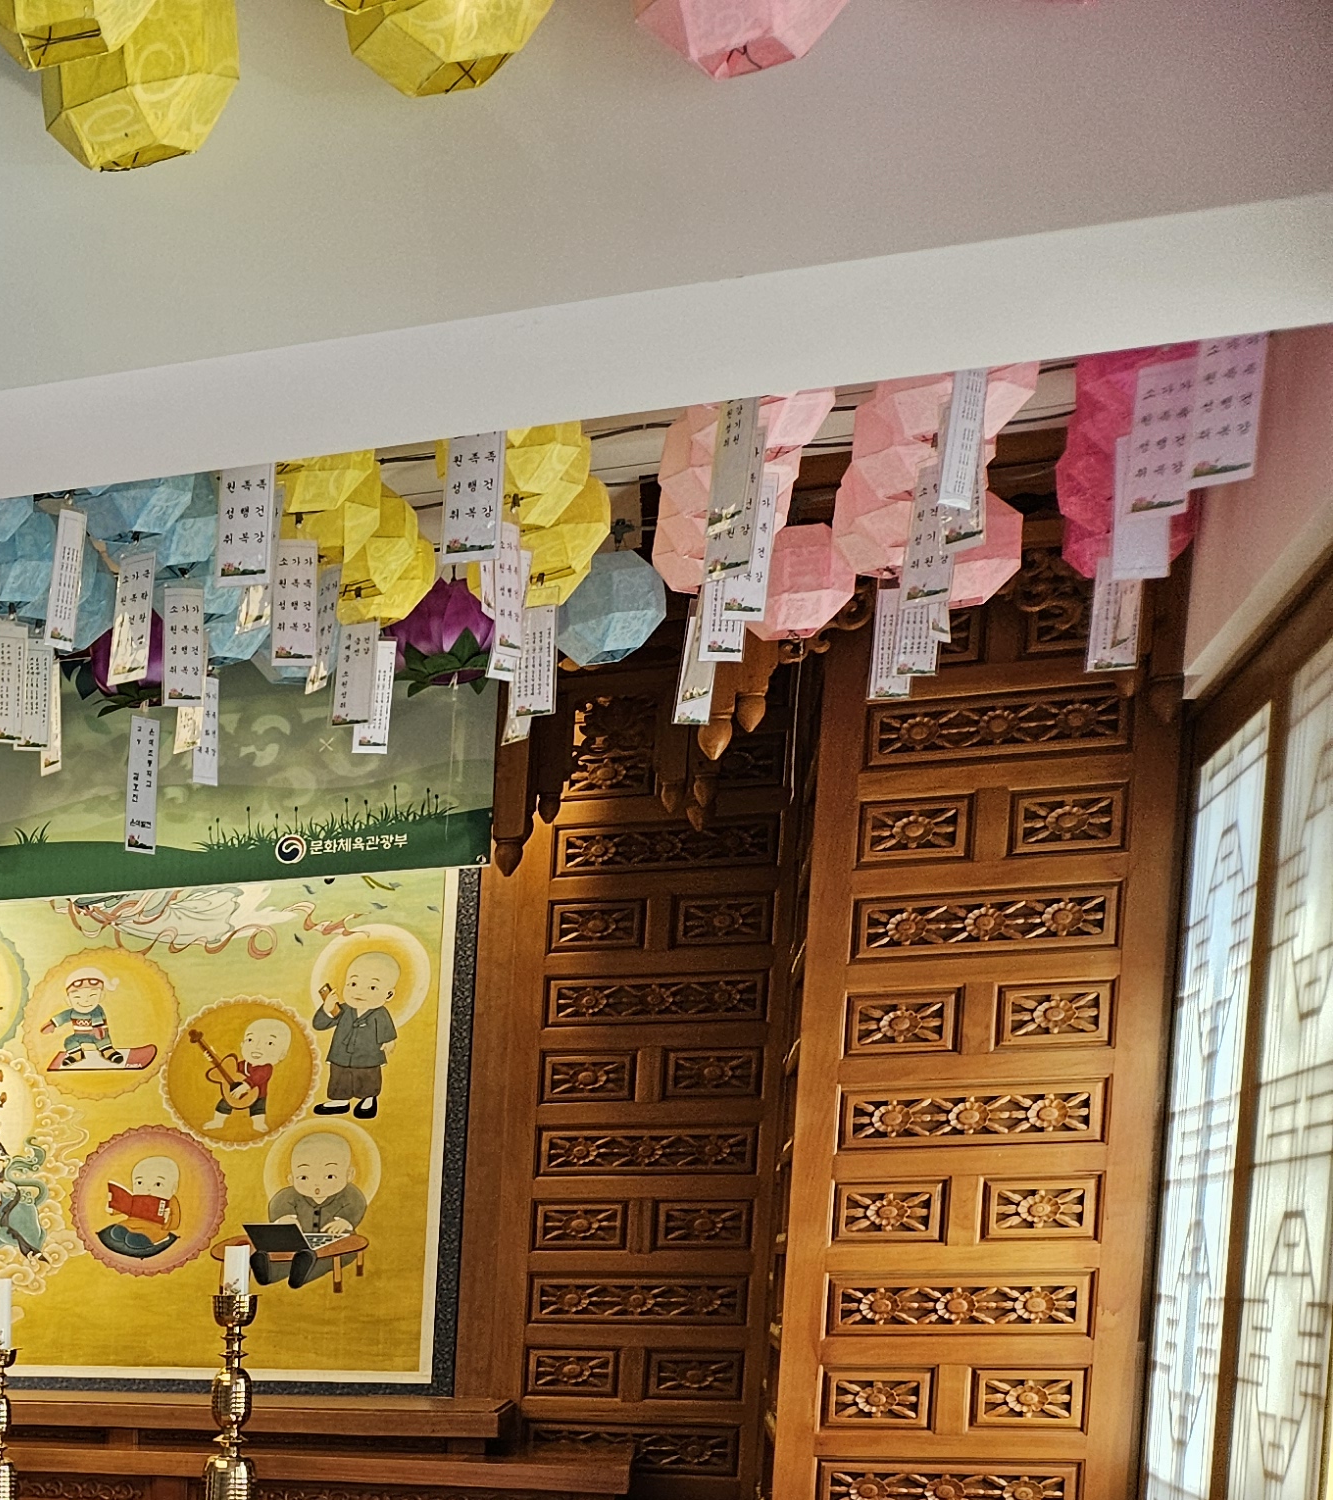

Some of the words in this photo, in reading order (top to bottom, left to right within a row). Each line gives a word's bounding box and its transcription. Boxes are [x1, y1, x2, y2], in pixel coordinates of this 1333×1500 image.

[223, 480, 236, 545] 원성취
[239, 480, 252, 543] 족행복
[254, 478, 267, 543] 족건강
[277, 557, 288, 632] 소원성취
[289, 557, 300, 632] 가족행복
[302, 556, 313, 633] 가족건강
[309, 833, 408, 855] 문화체육관광부
